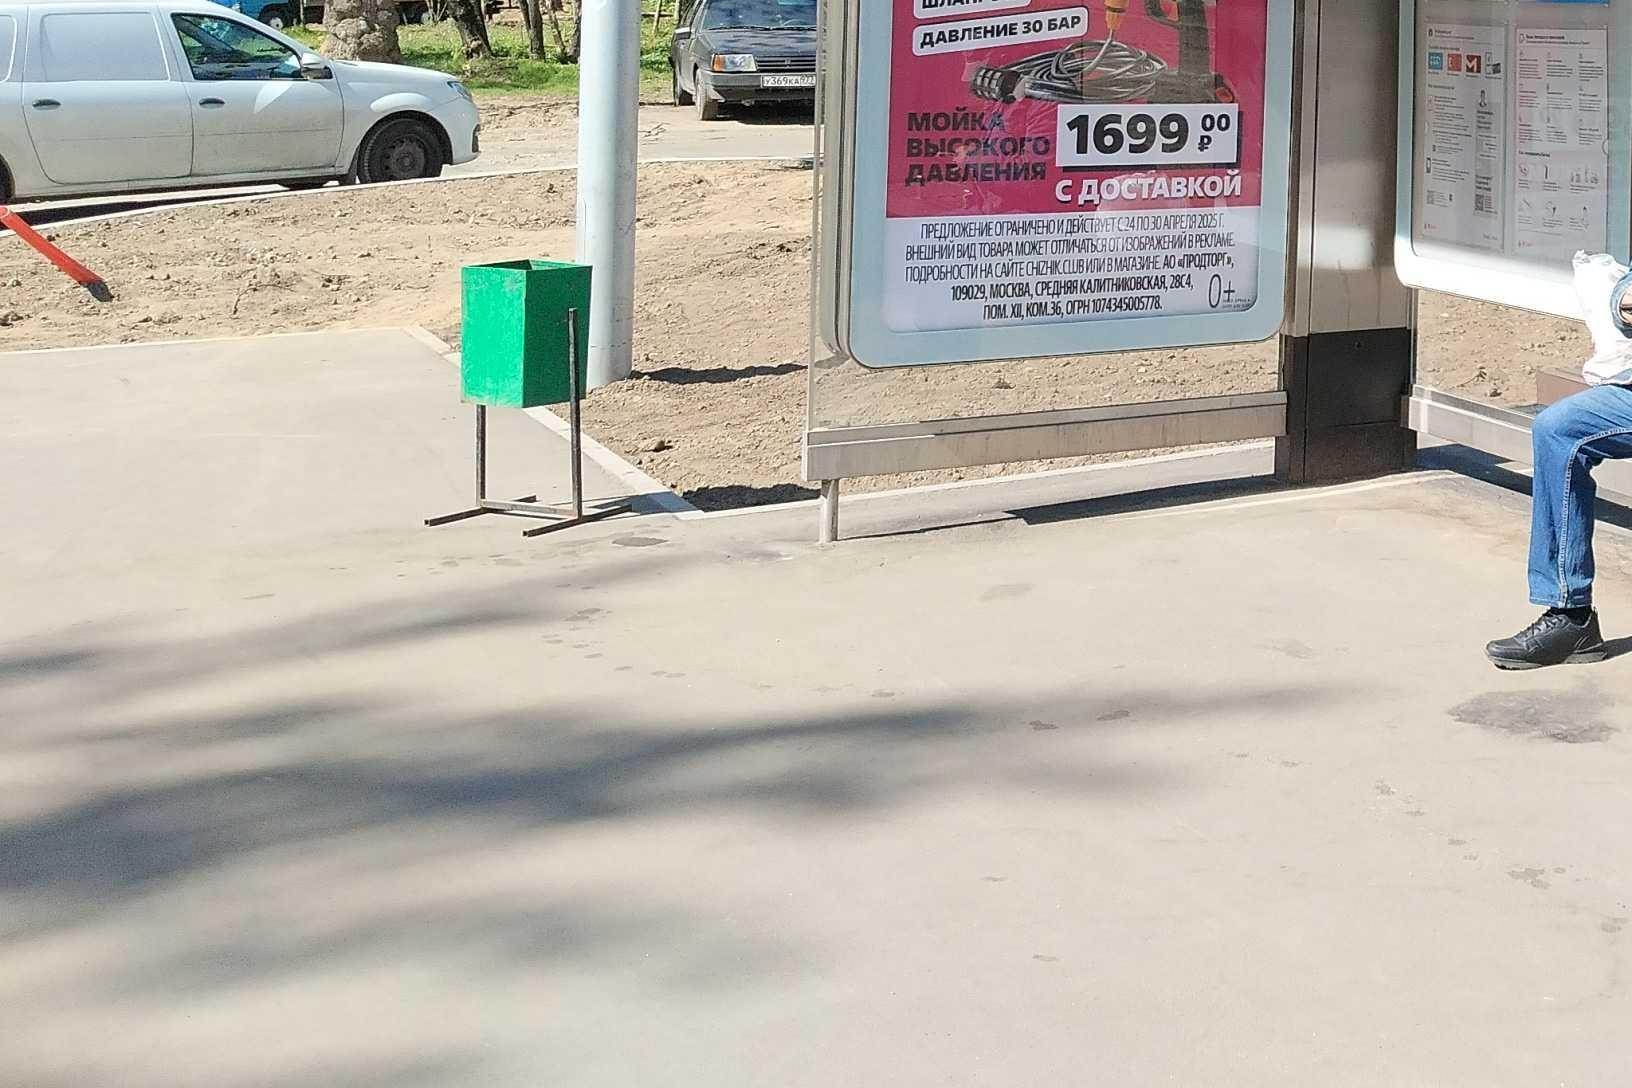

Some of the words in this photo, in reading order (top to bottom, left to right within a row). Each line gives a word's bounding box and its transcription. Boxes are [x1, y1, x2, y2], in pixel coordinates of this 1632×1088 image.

[920, 22, 1018, 49] ДАВЛЕНИЕ
[1022, 19, 1043, 34] 30
[1047, 15, 1081, 31] БАР
[907, 106, 1005, 132] МОЙКА
[906, 136, 1051, 158] ВЫСОКОГО
[1066, 113, 1190, 155] 1699
[1201, 113, 1231, 132] 00
[905, 162, 1047, 187] ДАВЛЕНИЯ
[1055, 179, 1072, 203] С
[1078, 169, 1242, 206] ДОСТАВКОЙ
[921, 221, 994, 241] ПРЕДЛОЖЕНИЕ
[995, 219, 1056, 238] ОГРАНИЧЕНО
[1057, 219, 1064, 235] И
[1065, 215, 1118, 237] ДЕЙСТВУЕТ
[1124, 216, 1135, 232] 24
[1136, 216, 1150, 231] ПО
[1150, 215, 1162, 230] 30
[1163, 214, 1197, 230] АПРЕЛЯ
[1198, 213, 1218, 229] 2025
[906, 240, 955, 261] ВНЕШНИЙ
[957, 243, 976, 261] ВИД
[979, 241, 1013, 258] ТОВАРА
[1015, 240, 1050, 256] МОЖЕТ
[1051, 237, 1107, 255] ОТЛИЧАТЬСЯ
[1108, 237, 1121, 253] ОТ
[1121, 231, 1187, 252] ИЗОБРАЖЕНИЙ
[1188, 234, 1194, 249] В
[1195, 232, 1236, 249] РЕКЛАМЕ.
[905, 263, 978, 284] ПОДРОБНОСТИ
[979, 262, 993, 278] НА
[994, 259, 1025, 278] САЙТЕ
[1026, 257, 1085, 277] CHIZHIK.CLUB
[1085, 258, 1106, 274] ИЛИ
[1107, 257, 1113, 272] В
[1114, 255, 1160, 272] МАГАЗИНЕ.
[1163, 254, 1176, 269] АО
[1177, 252, 1234, 272] «ПРОДТОРГ»,
[951, 284, 988, 302] 109029,
[989, 282, 1033, 300] МОСКВА,
[1035, 279, 1078, 299] СРЕДНЯЯ
[1079, 274, 1168, 294] КАЛИТНИКОВСКАЯ,
[1208, 273, 1236, 309] 0+
[983, 303, 1009, 320] ПОМ.
[1025, 300, 1063, 318] КОМ.36,
[1065, 298, 1090, 316] ОГРН
[1091, 295, 1163, 314] 1074345005778.
